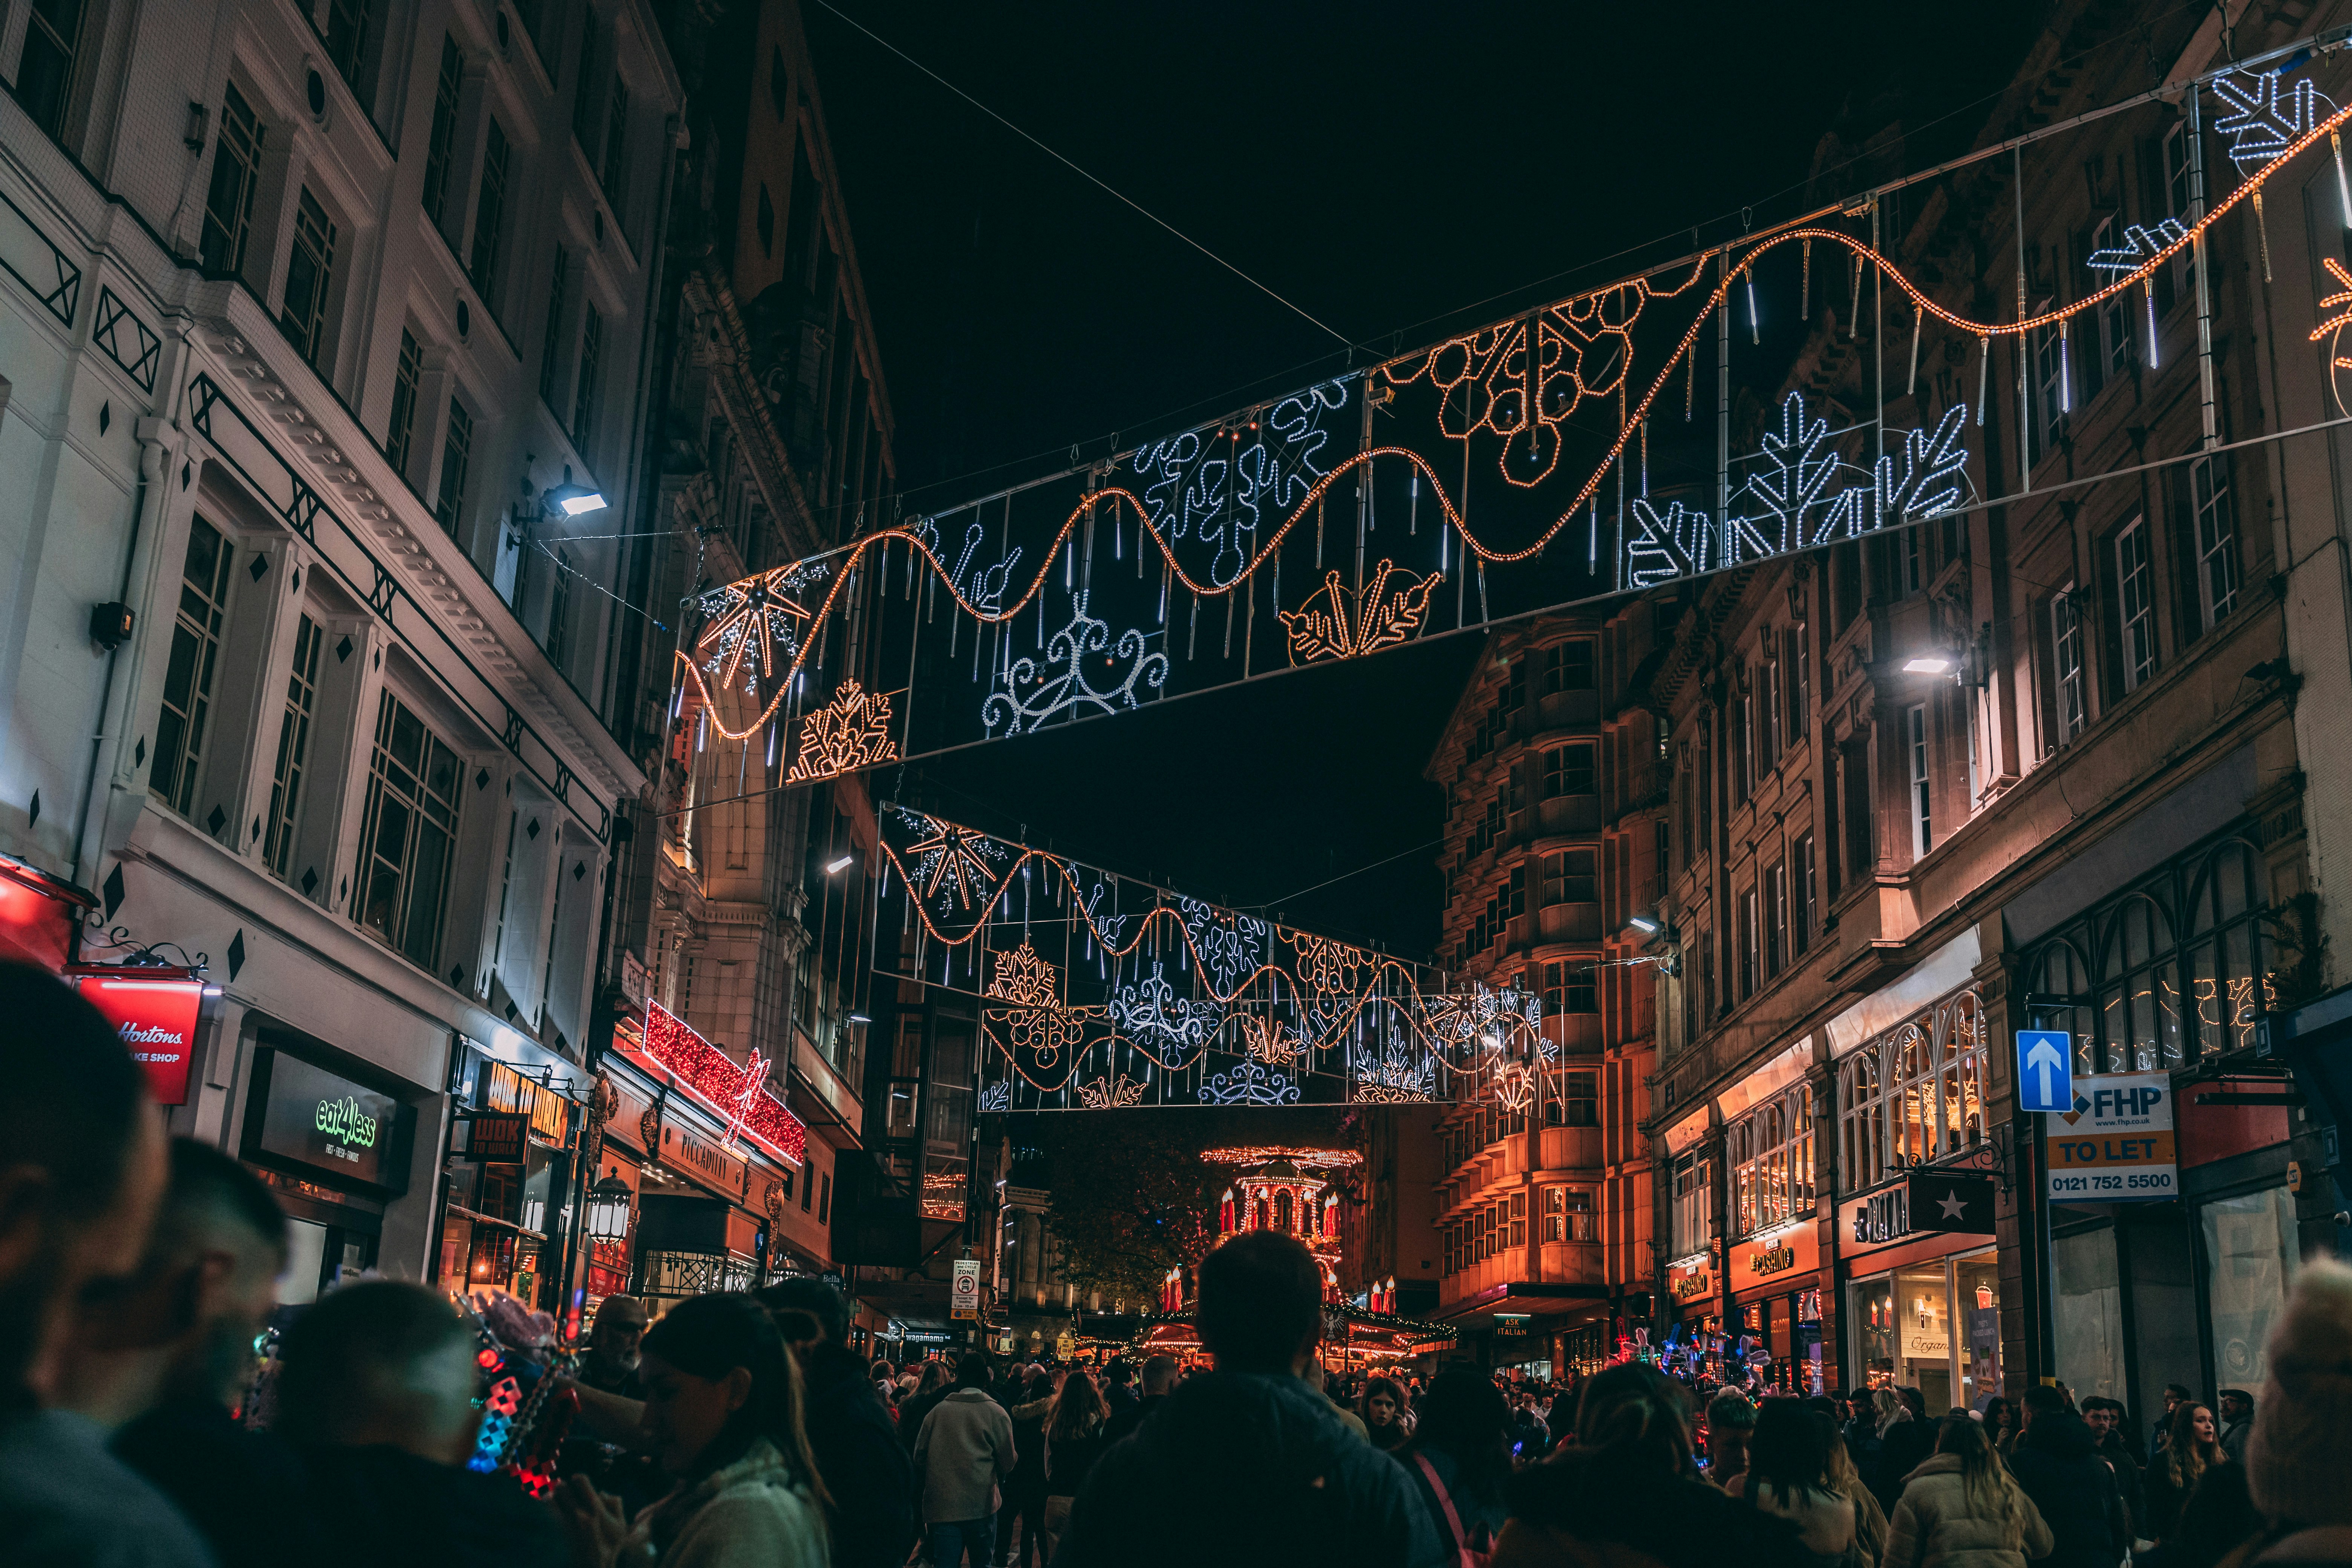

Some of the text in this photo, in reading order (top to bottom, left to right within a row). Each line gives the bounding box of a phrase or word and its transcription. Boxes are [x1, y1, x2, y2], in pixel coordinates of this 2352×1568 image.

[150, 1054, 179, 1062] SHOP
[488, 1061, 564, 1139] WOK TO WALK
[2093, 1087, 2161, 1118] FHP
[316, 1096, 375, 1147] eat4less
[475, 1118, 520, 1142] WOK
[2095, 1118, 2150, 1126] www.fhp.co.uk
[326, 1144, 358, 1162] FAST FRESH FAMOUS
[474, 1141, 517, 1155] TO WALK
[681, 1134, 728, 1180] PICCADILLY
[2059, 1139, 2157, 1162] TO LET
[2053, 1174, 2170, 1191] 0121 752 5500
[1867, 1192, 1888, 1243] PRET
[1757, 1248, 1790, 1276] CASHINO
[1680, 1274, 1704, 1298] CASHINO
[1911, 1336, 1949, 1353] Organ
[1813, 1377, 1820, 1392] 24
